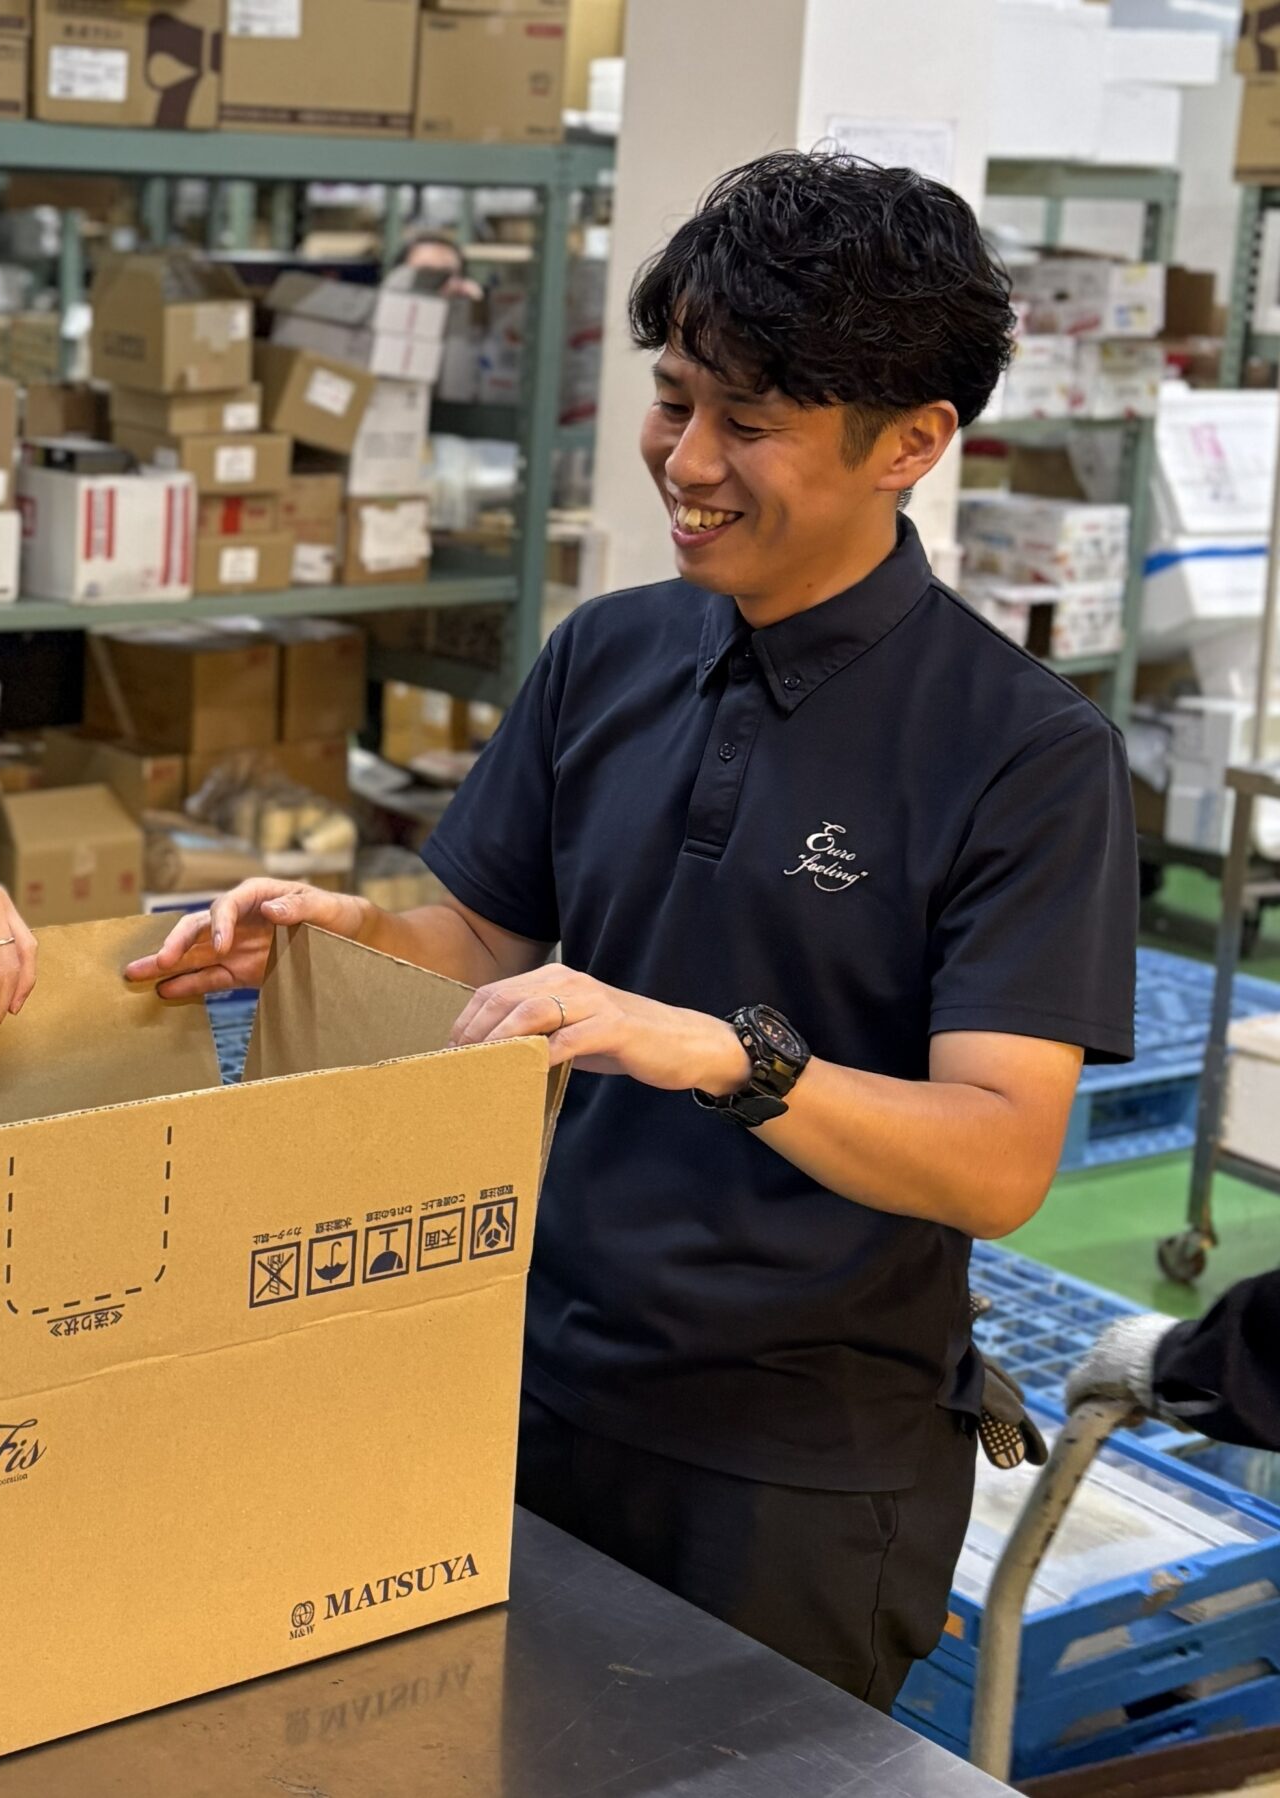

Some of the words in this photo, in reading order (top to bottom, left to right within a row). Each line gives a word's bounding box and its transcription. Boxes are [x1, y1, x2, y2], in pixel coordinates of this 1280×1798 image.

[806, 821, 856, 860] Euro
[366, 1204, 413, 1223] われもの注意
[253, 1226, 302, 1245] カッター禁止
[423, 1226, 458, 1251] 天面
[323, 1553, 479, 1620] MATSUYA
[289, 1624, 316, 1640] M&W
